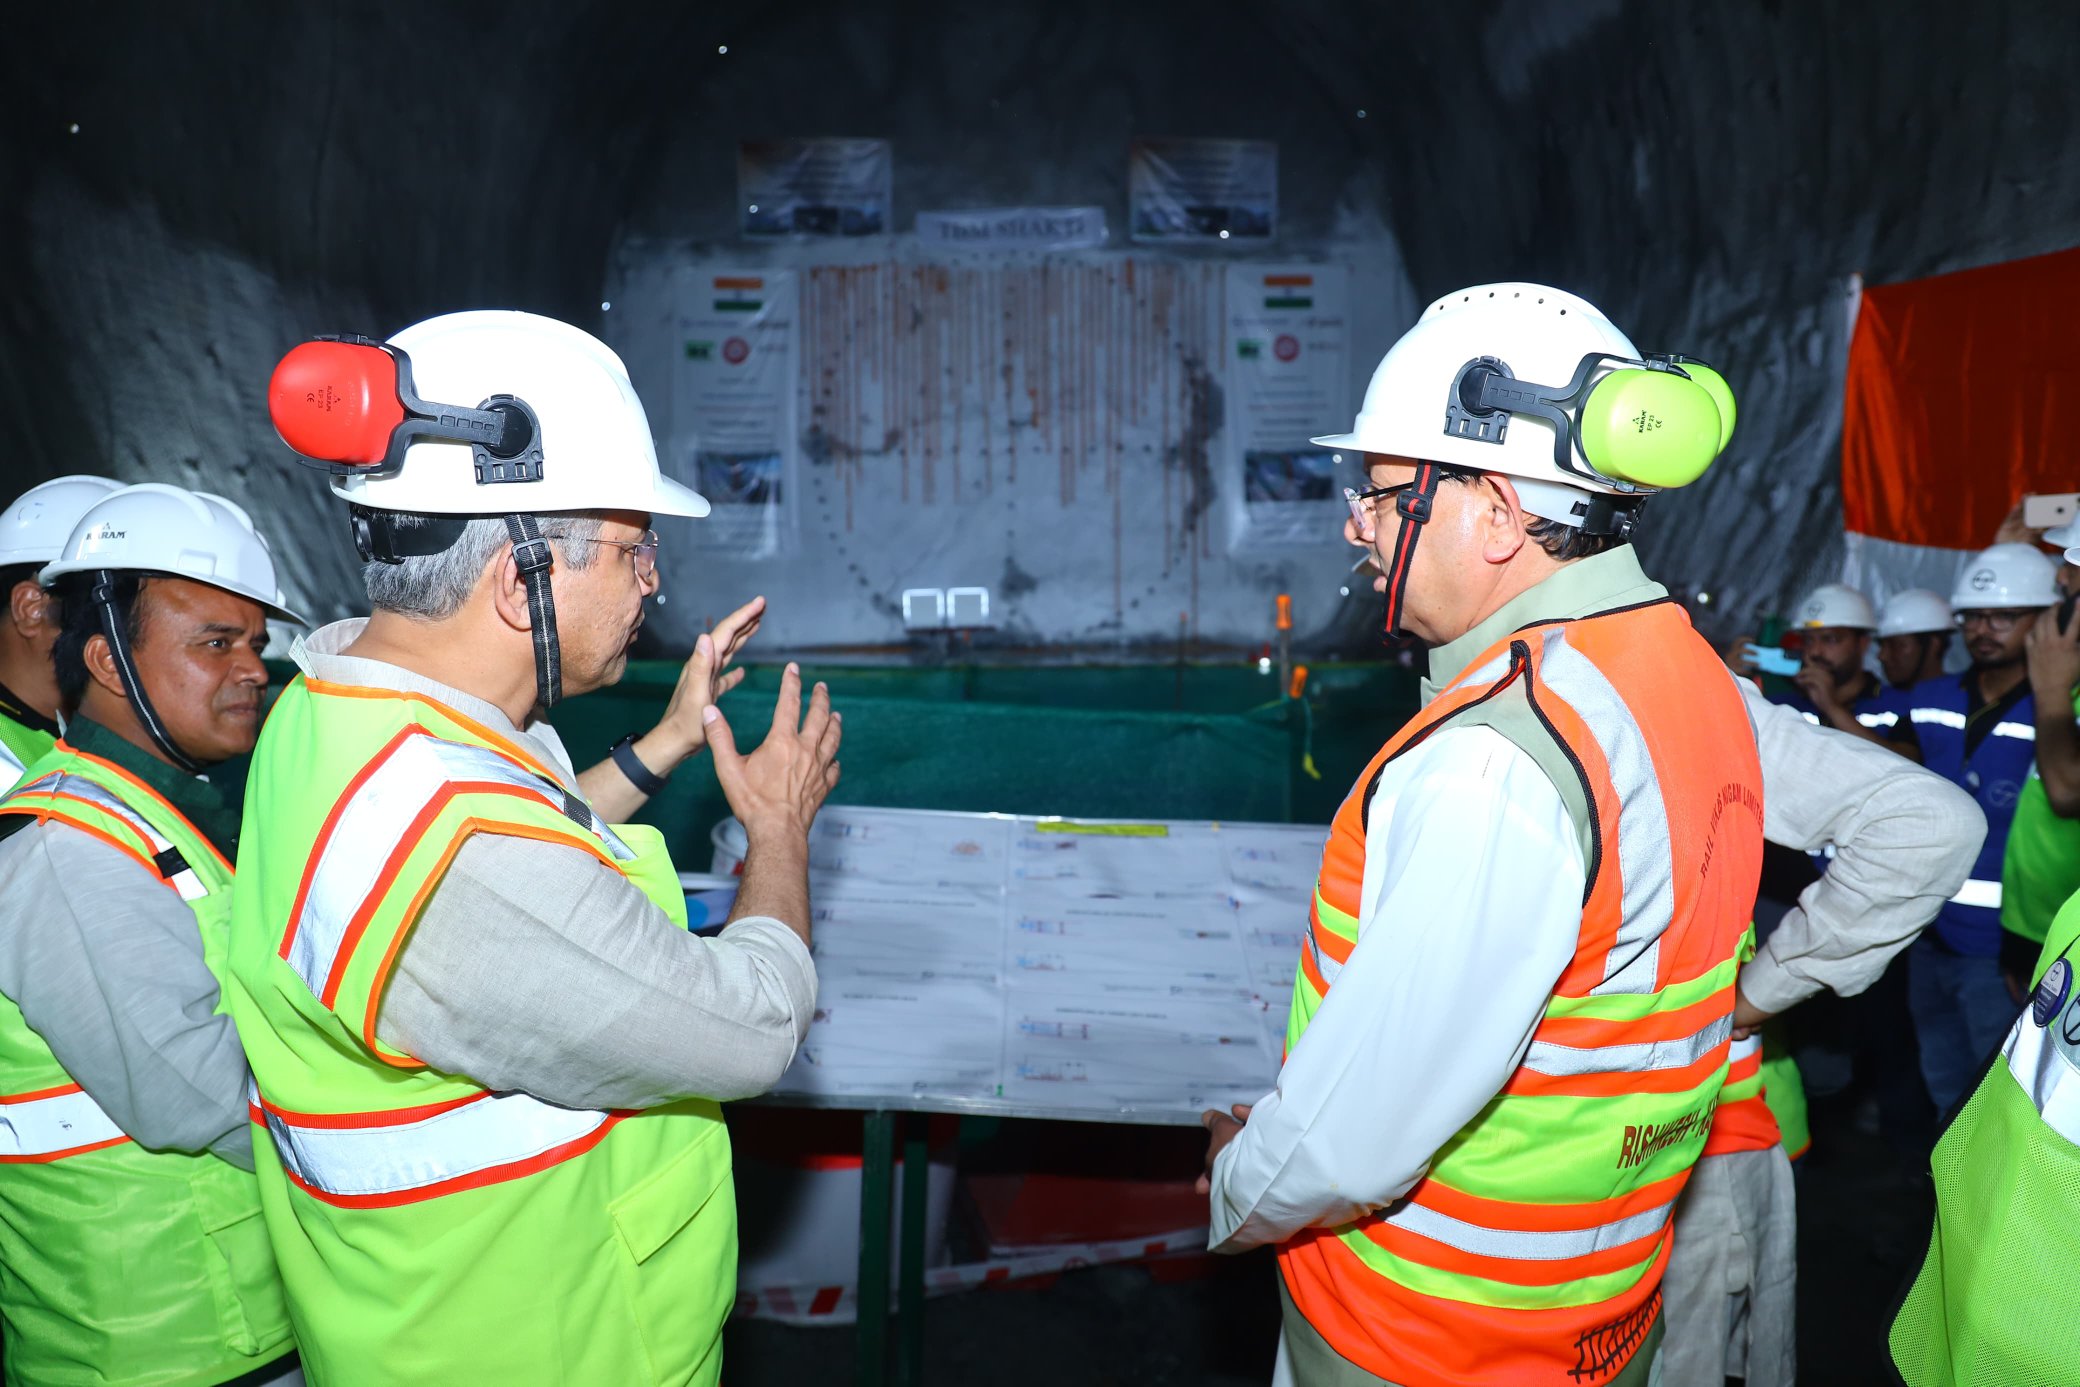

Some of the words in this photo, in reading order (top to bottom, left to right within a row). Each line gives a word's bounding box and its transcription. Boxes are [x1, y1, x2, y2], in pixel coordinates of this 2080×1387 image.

[1638, 410, 1647, 433] KARAM
[1646, 422, 1653, 432] EP
[86, 530, 127, 541] KRAM
[1700, 834, 1714, 879] RAIL
[1721, 782, 1742, 807] NIGAM
